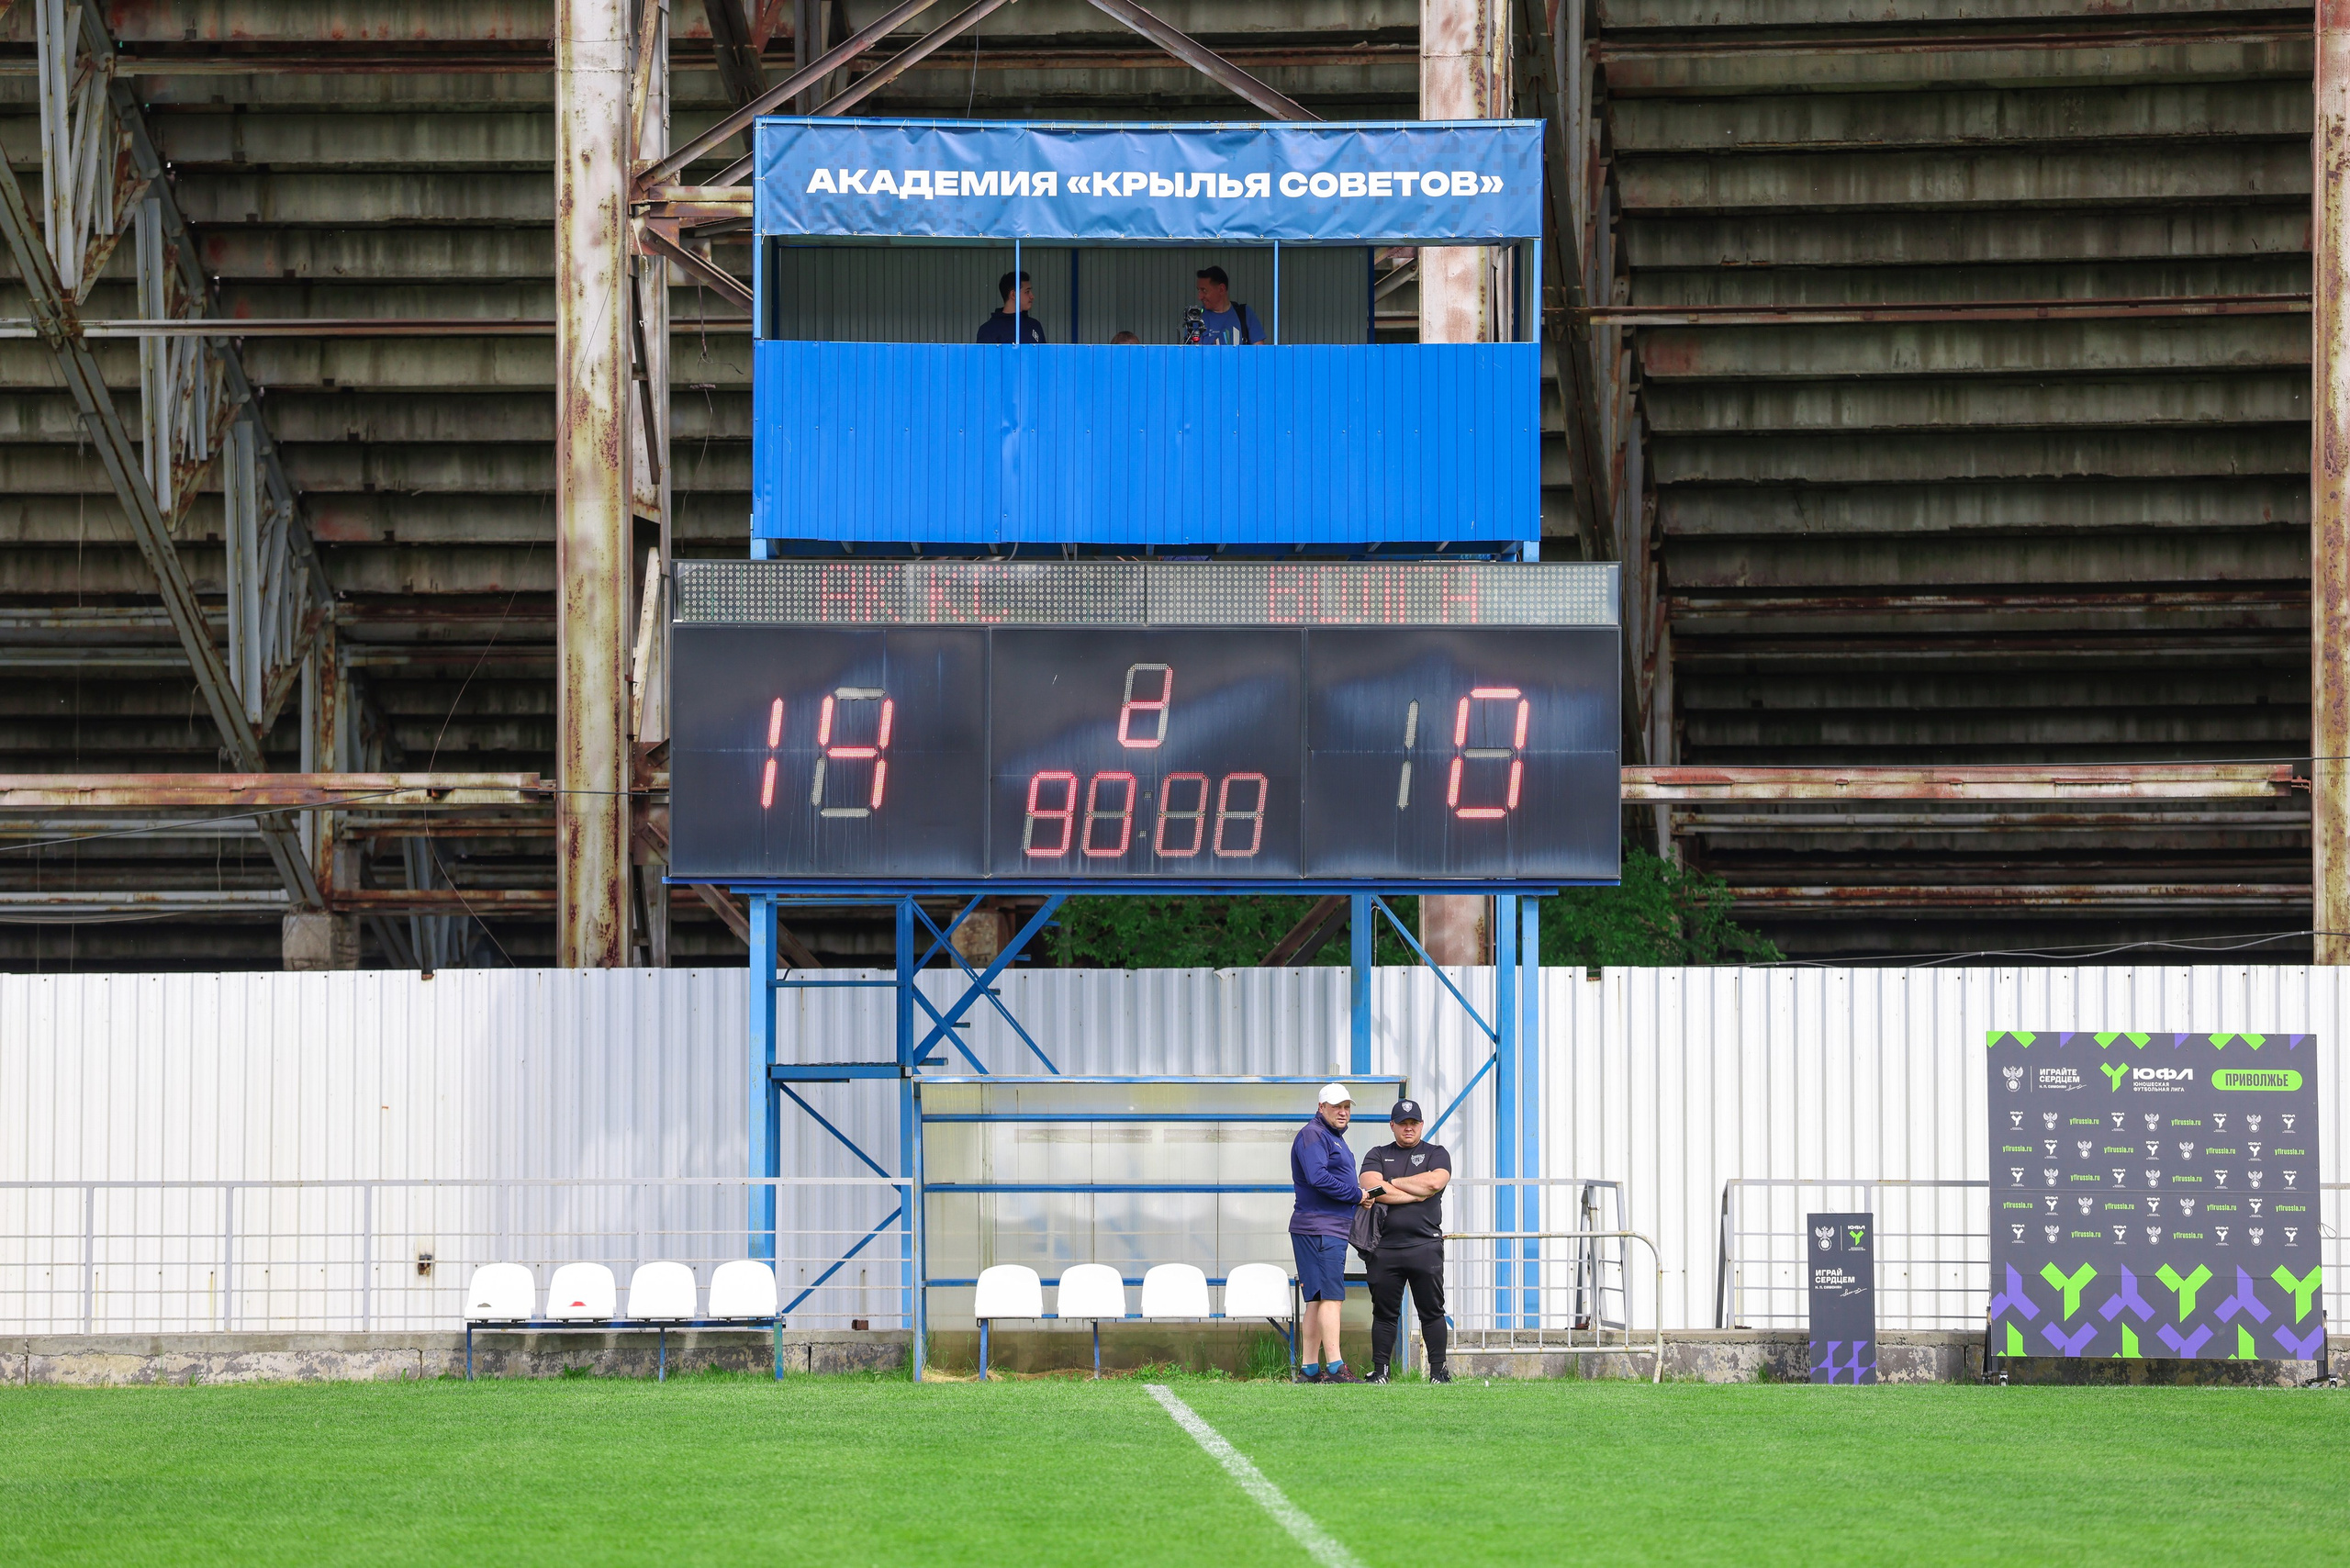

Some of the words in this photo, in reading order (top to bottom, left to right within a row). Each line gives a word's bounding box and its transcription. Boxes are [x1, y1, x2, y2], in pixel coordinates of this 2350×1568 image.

[806, 168, 1058, 200] АКАДЕМИЯ
[1067, 171, 1270, 198] «КРЫЛЬЯ
[1279, 171, 1505, 198] СОВЕТОВ»
[2039, 1067, 2077, 1076] ИГРАЙТЕ
[2132, 1068, 2194, 1081] ЮФЛ
[2039, 1076, 2080, 1084] СЕРДЦЕМ
[2225, 1073, 2289, 1087] ПРИВОЛЖЬЕ
[1815, 1268, 1842, 1276] ИГРАЙ
[1815, 1276, 1855, 1284] СЕРДЦЕМ
